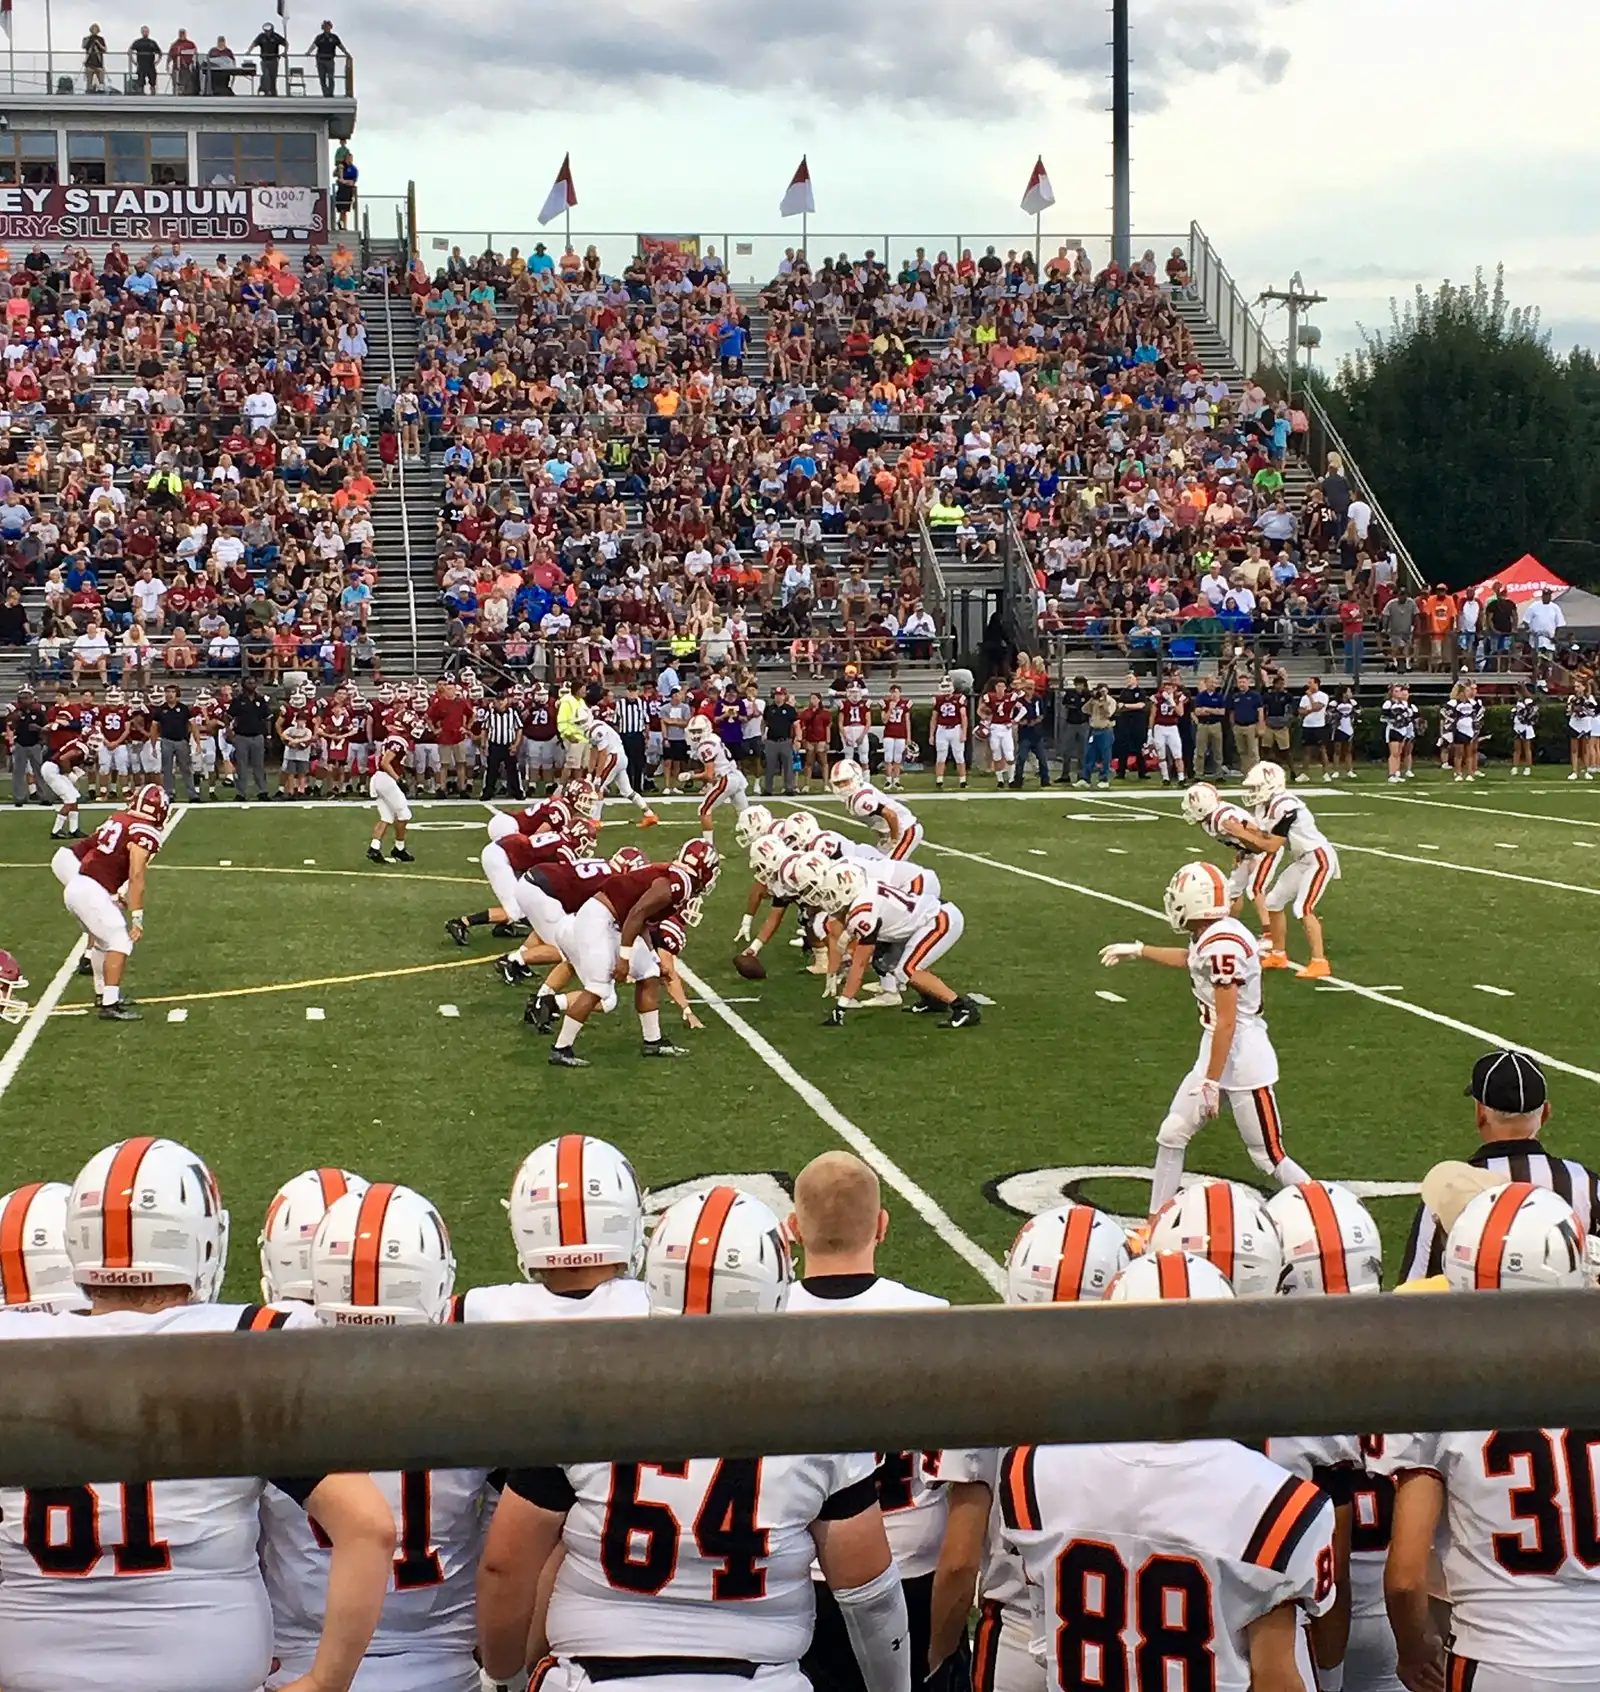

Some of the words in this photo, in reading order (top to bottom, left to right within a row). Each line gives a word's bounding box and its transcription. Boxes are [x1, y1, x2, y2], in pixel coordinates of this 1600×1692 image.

[0, 188, 52, 212] EY
[64, 188, 247, 214] STADIUM
[259, 190, 273, 208] Q
[275, 191, 304, 201] 100.7
[160, 217, 250, 239] FIELD
[1507, 581, 1539, 592] State
[105, 712, 121, 730] 56
[532, 708, 549, 725] 79
[1210, 954, 1236, 975] 15
[545, 1252, 604, 1266] Riddell
[89, 1270, 153, 1284] Riddell
[336, 1311, 396, 1325] Riddell
[600, 1457, 770, 1600] 64
[1055, 1538, 1217, 1692] 88
